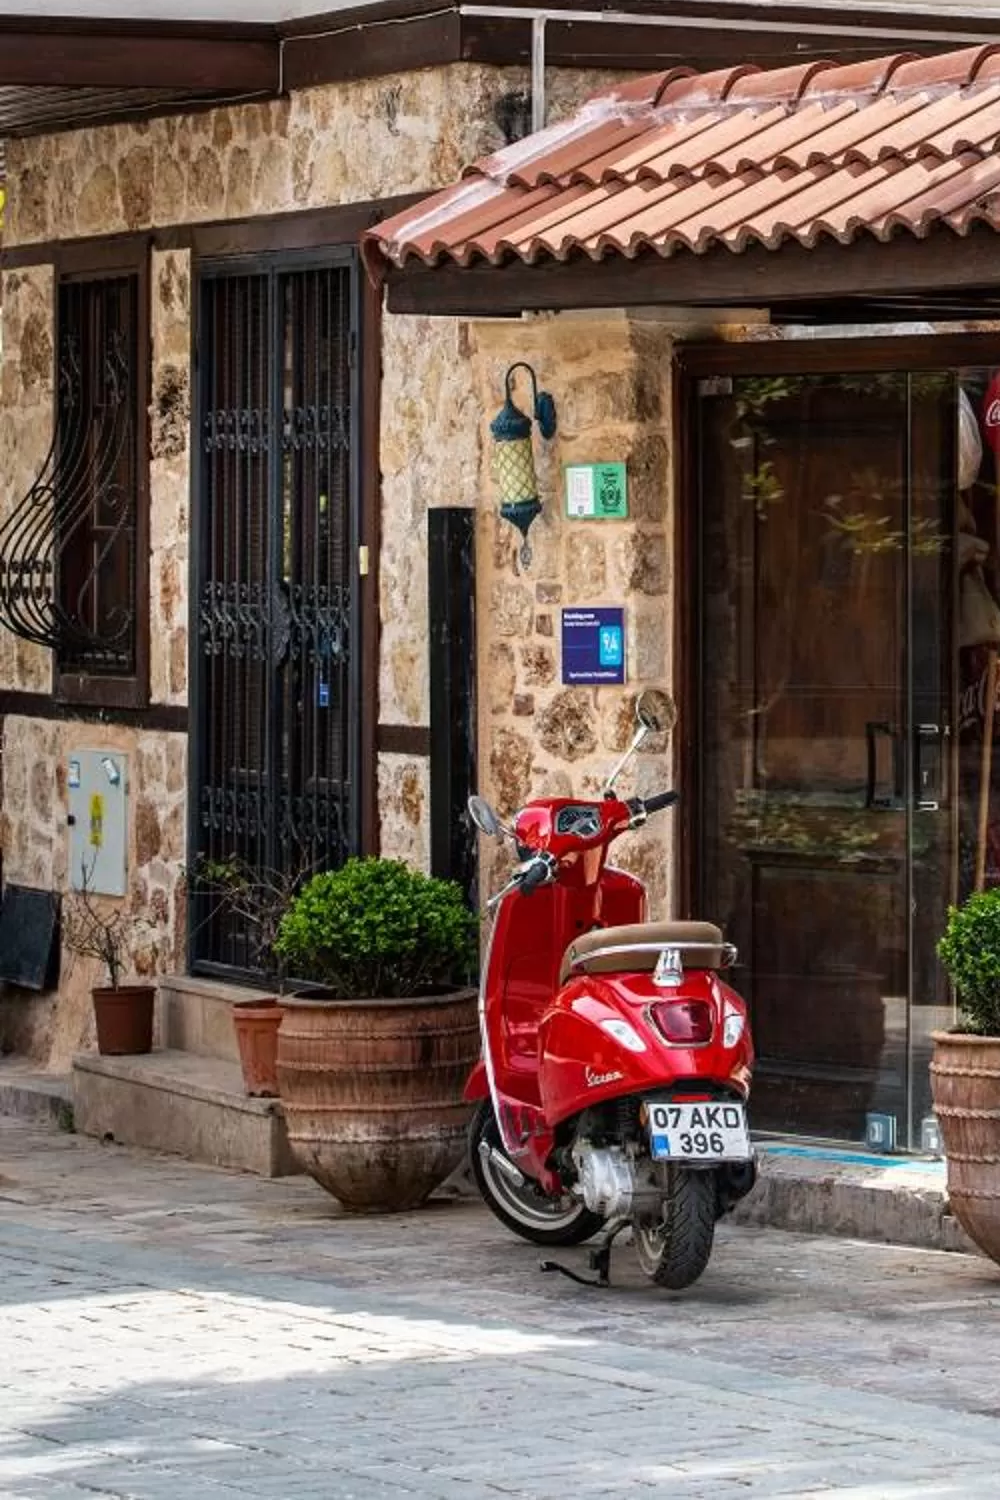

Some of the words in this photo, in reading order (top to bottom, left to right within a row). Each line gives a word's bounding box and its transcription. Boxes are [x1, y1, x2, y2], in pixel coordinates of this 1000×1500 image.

[653, 1107, 681, 1129] 07
[690, 1106, 740, 1129] AKD
[680, 1132, 724, 1154] 396
